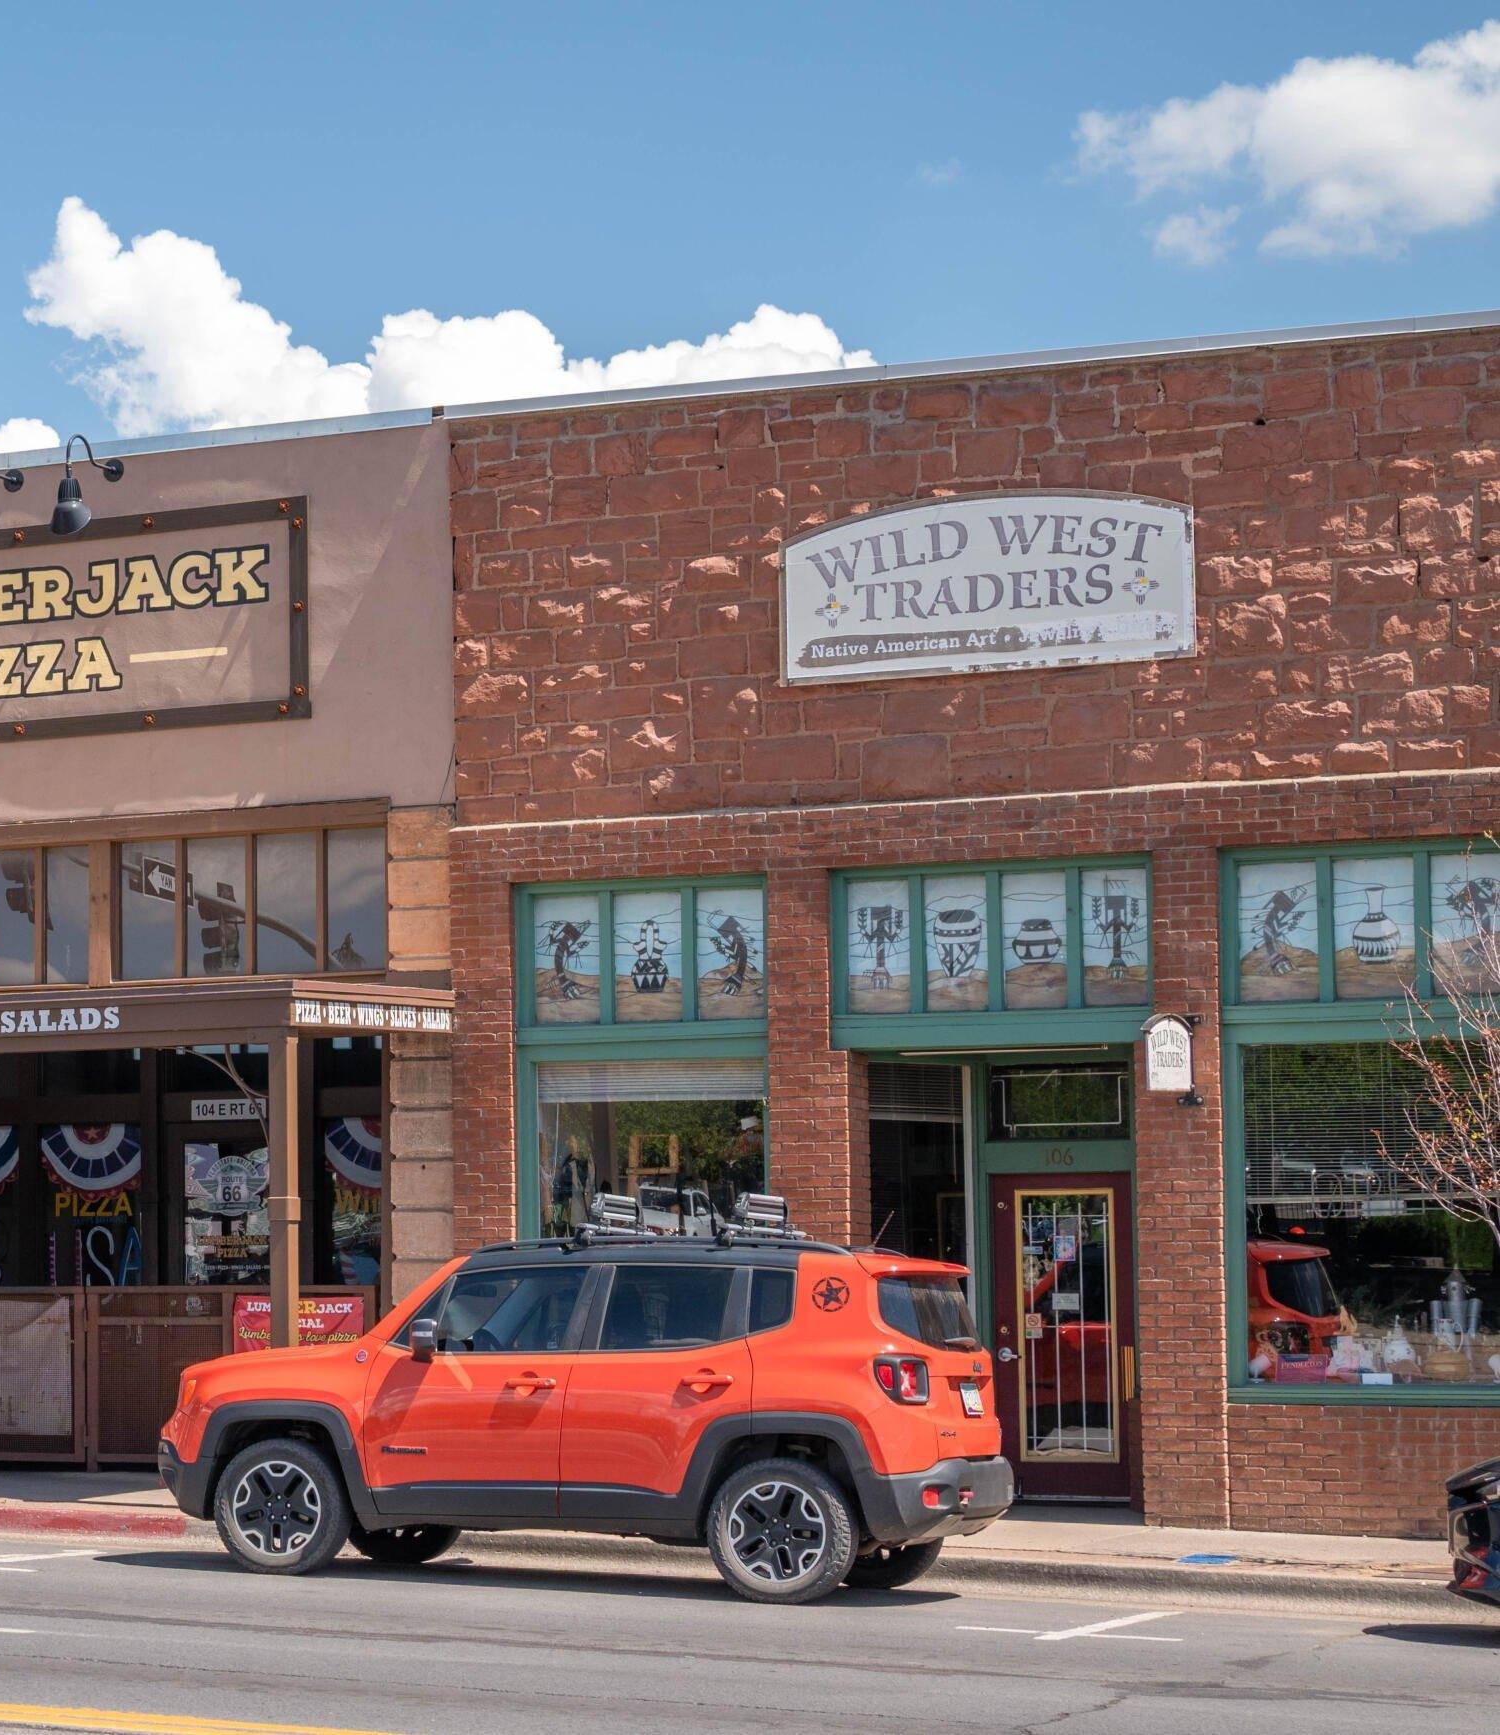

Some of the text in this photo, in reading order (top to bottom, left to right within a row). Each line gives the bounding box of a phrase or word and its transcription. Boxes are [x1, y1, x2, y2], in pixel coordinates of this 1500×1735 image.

[805, 513, 1164, 590] WILD WEST
[854, 564, 1114, 622] TRADERS
[811, 643, 869, 660] Native
[874, 636, 961, 656] American
[968, 632, 997, 649] Art
[0, 1007, 120, 1034] SALADS
[295, 1000, 450, 1030] PIZZA BEER WINGS SLICES SALADS
[1151, 1029, 1188, 1053] WILD WEST
[1156, 1051, 1184, 1068] TRADERS
[195, 1102, 263, 1117] 104 E RT 66
[1044, 1148, 1075, 1167] 106
[221, 1176, 244, 1184] ROUTE
[222, 1185, 242, 1202] 66
[55, 1191, 133, 1217] PIZZA
[216, 1247, 248, 1258] PIZZA
[306, 1330, 327, 1342] love
[327, 1331, 358, 1344] pizza
[1280, 1359, 1323, 1370] PENDLETON
